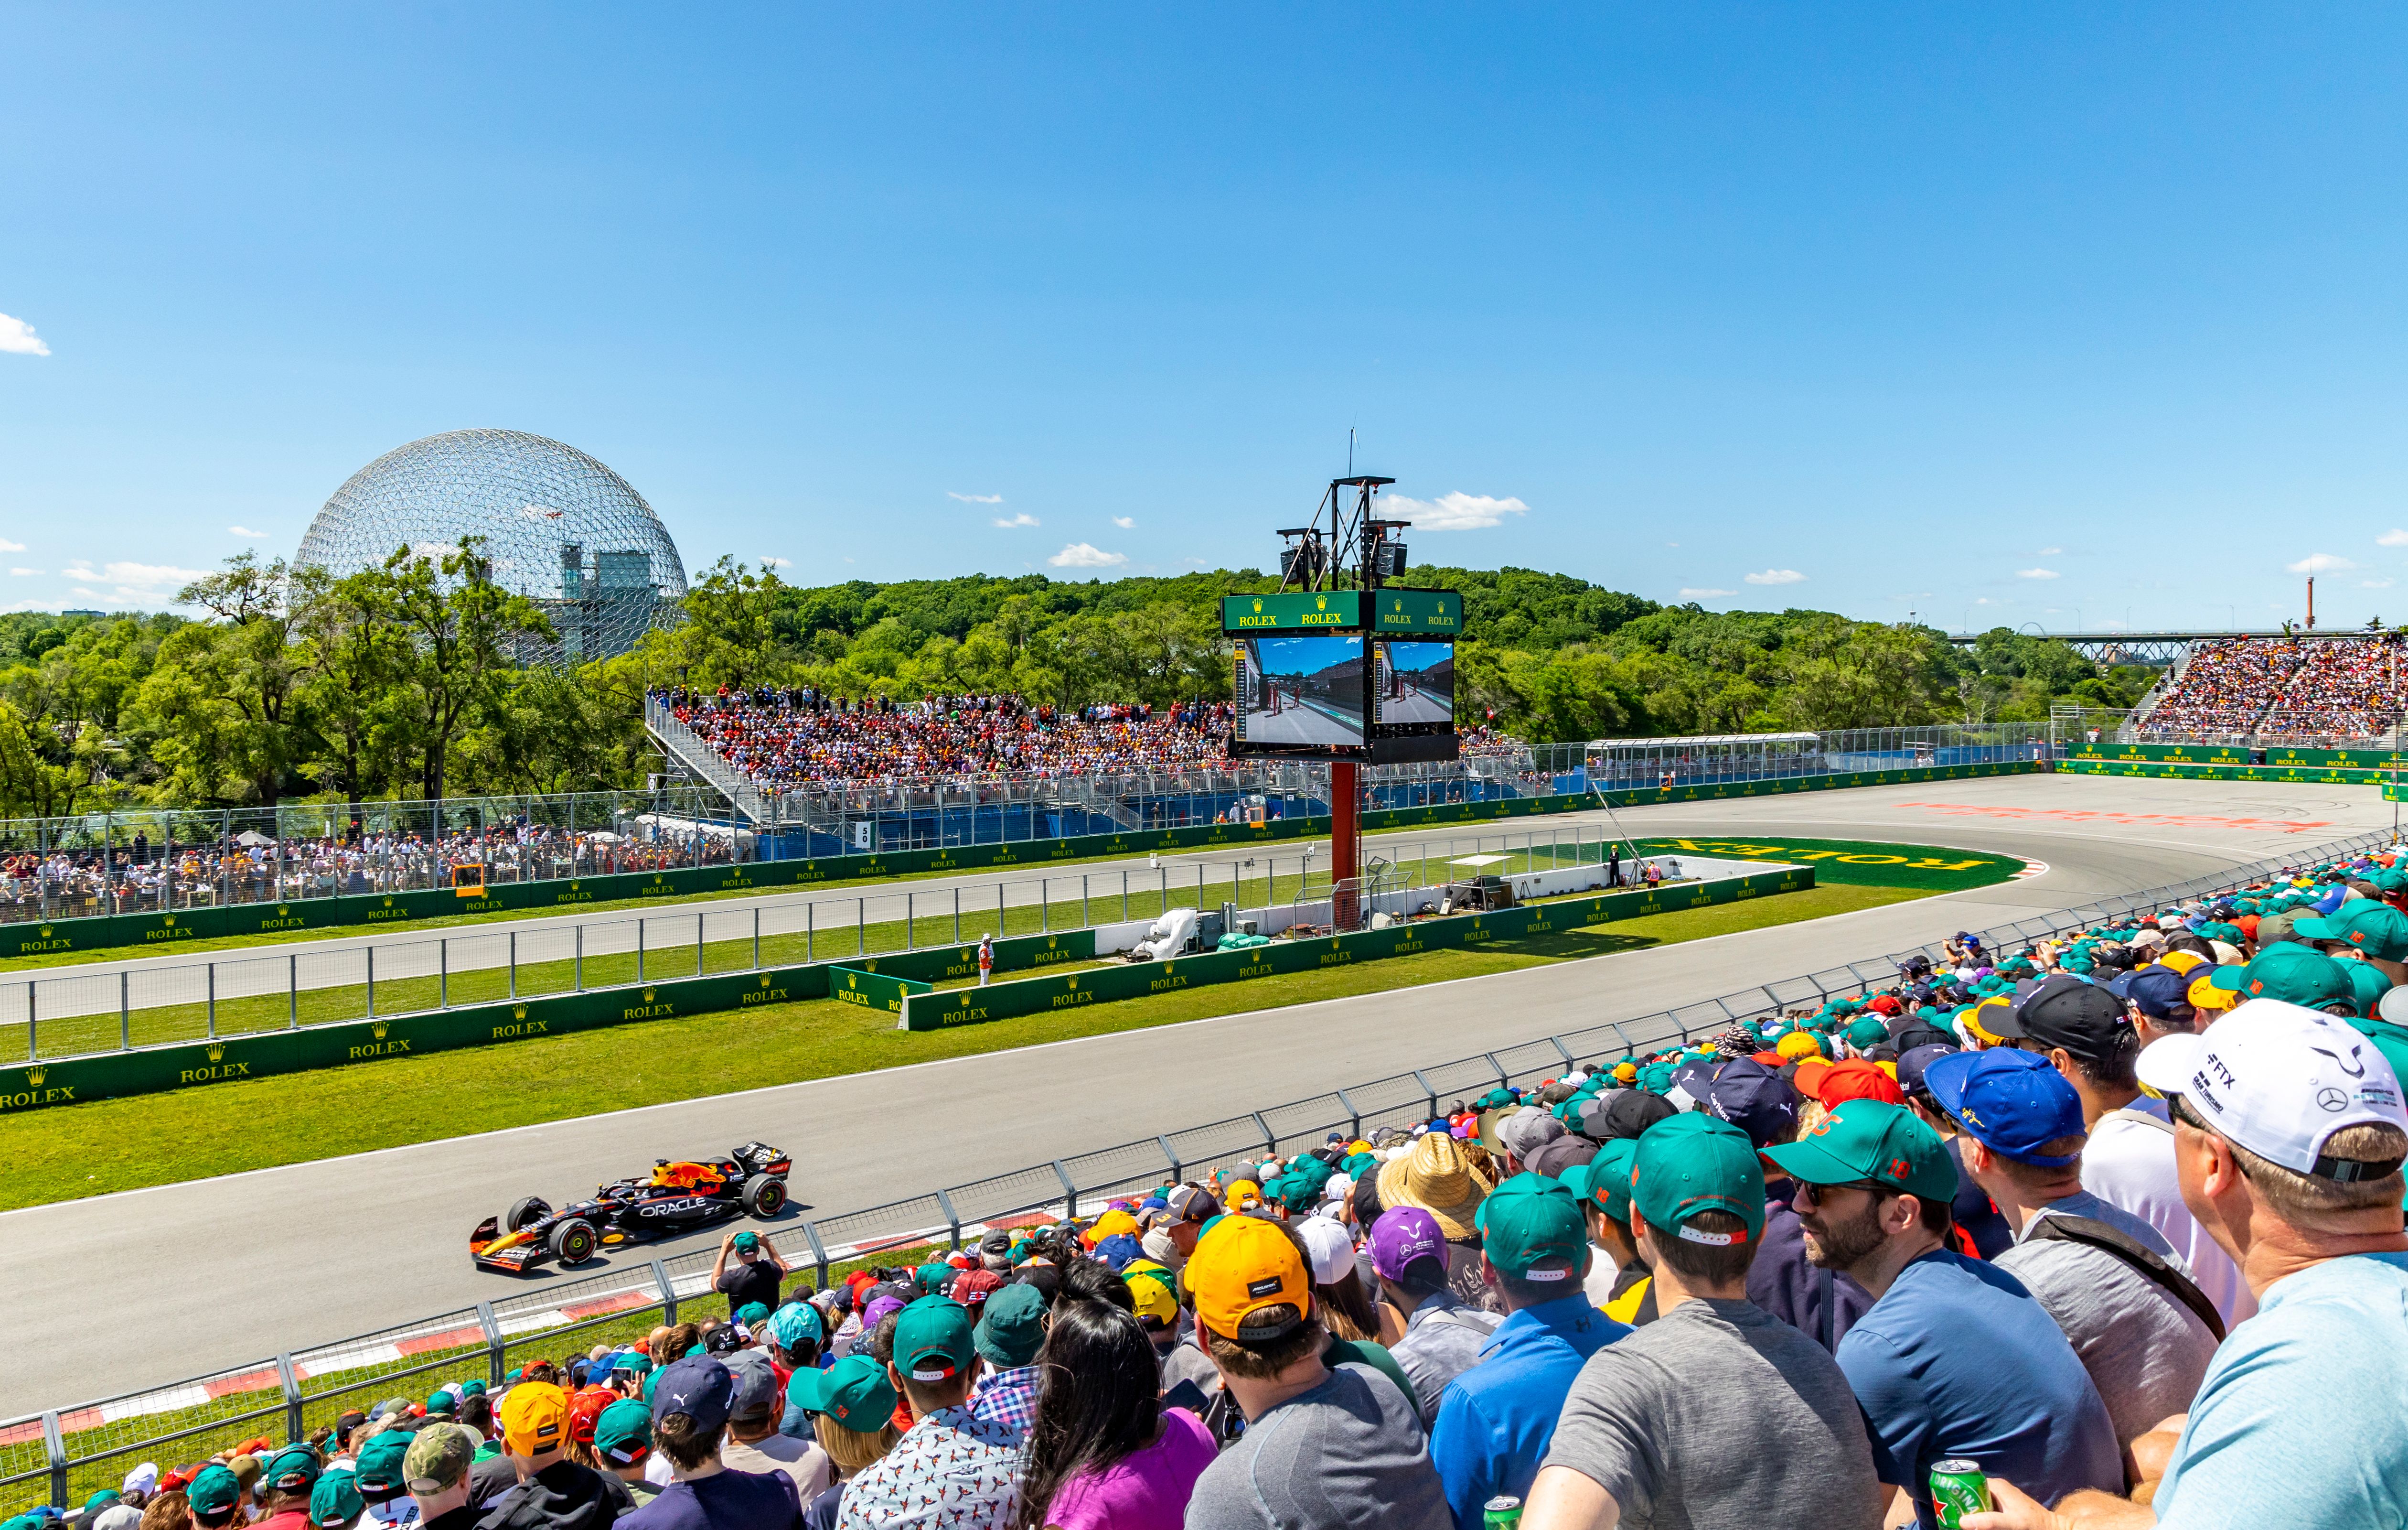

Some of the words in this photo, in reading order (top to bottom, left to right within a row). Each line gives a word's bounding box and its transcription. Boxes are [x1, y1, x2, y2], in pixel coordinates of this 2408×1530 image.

[1240, 615, 1276, 626] ROLEX
[1302, 614, 1342, 624] ROLEX
[1384, 614, 1411, 624] ROLEX
[1428, 616, 1454, 625] ROLEX
[931, 860, 956, 868] ROLEX
[993, 854, 1017, 862] ROLEX
[797, 872, 825, 880] ROLEX
[860, 866, 886, 874] ROLEX
[722, 878, 752, 887] ROLEX
[1780, 882, 1798, 890] ROLEX
[642, 885, 674, 895] ROLEX
[1737, 888, 1755, 897] ROLEX
[558, 892, 592, 902] ROLEX
[1691, 895, 1711, 905] ROLEX
[466, 900, 503, 910] ROLEX
[1640, 904, 1660, 913] ROLEX
[368, 908, 408, 919] ROLEX
[1587, 912, 1609, 923] ROLEX
[261, 918, 304, 929] ROLEX
[1528, 922, 1551, 932] ROLEX
[146, 927, 193, 939] ROLEX
[1465, 930, 1489, 941] ROLEX
[2349, 930, 2365, 943] 18
[21, 938, 72, 952] ROLEX
[1395, 941, 1423, 953] ROLEX
[1035, 950, 1069, 963] ROLEX
[1321, 951, 1351, 964] ROLEX
[947, 964, 979, 976] ROLE
[1240, 964, 1273, 977] ROLEX
[1151, 976, 1187, 990] ROLEX
[2249, 979, 2263, 995] 18
[742, 989, 788, 1003] ROLEX
[838, 990, 869, 1005] ROLEX
[1053, 992, 1093, 1005] ROLEX
[623, 1004, 673, 1020] ROLEX
[943, 1008, 987, 1024] ROLEX
[492, 1021, 547, 1038] ROLEX
[349, 1040, 411, 1058] ROLEX
[181, 1062, 249, 1083] ROLEX
[2214, 1061, 2236, 1090] FTX
[0, 1087, 75, 1108] ROLEX
[2203, 1088, 2224, 1111] TURISMO
[1711, 1093, 1730, 1122] CarNext
[1888, 1158, 1910, 1179] 18
[706, 1184, 720, 1195] Bull
[1596, 1187, 1609, 1203] 18
[640, 1197, 706, 1217] ORACLE
[835, 1405, 849, 1418] 18
[1934, 1472, 1980, 1515] ORIGINA
